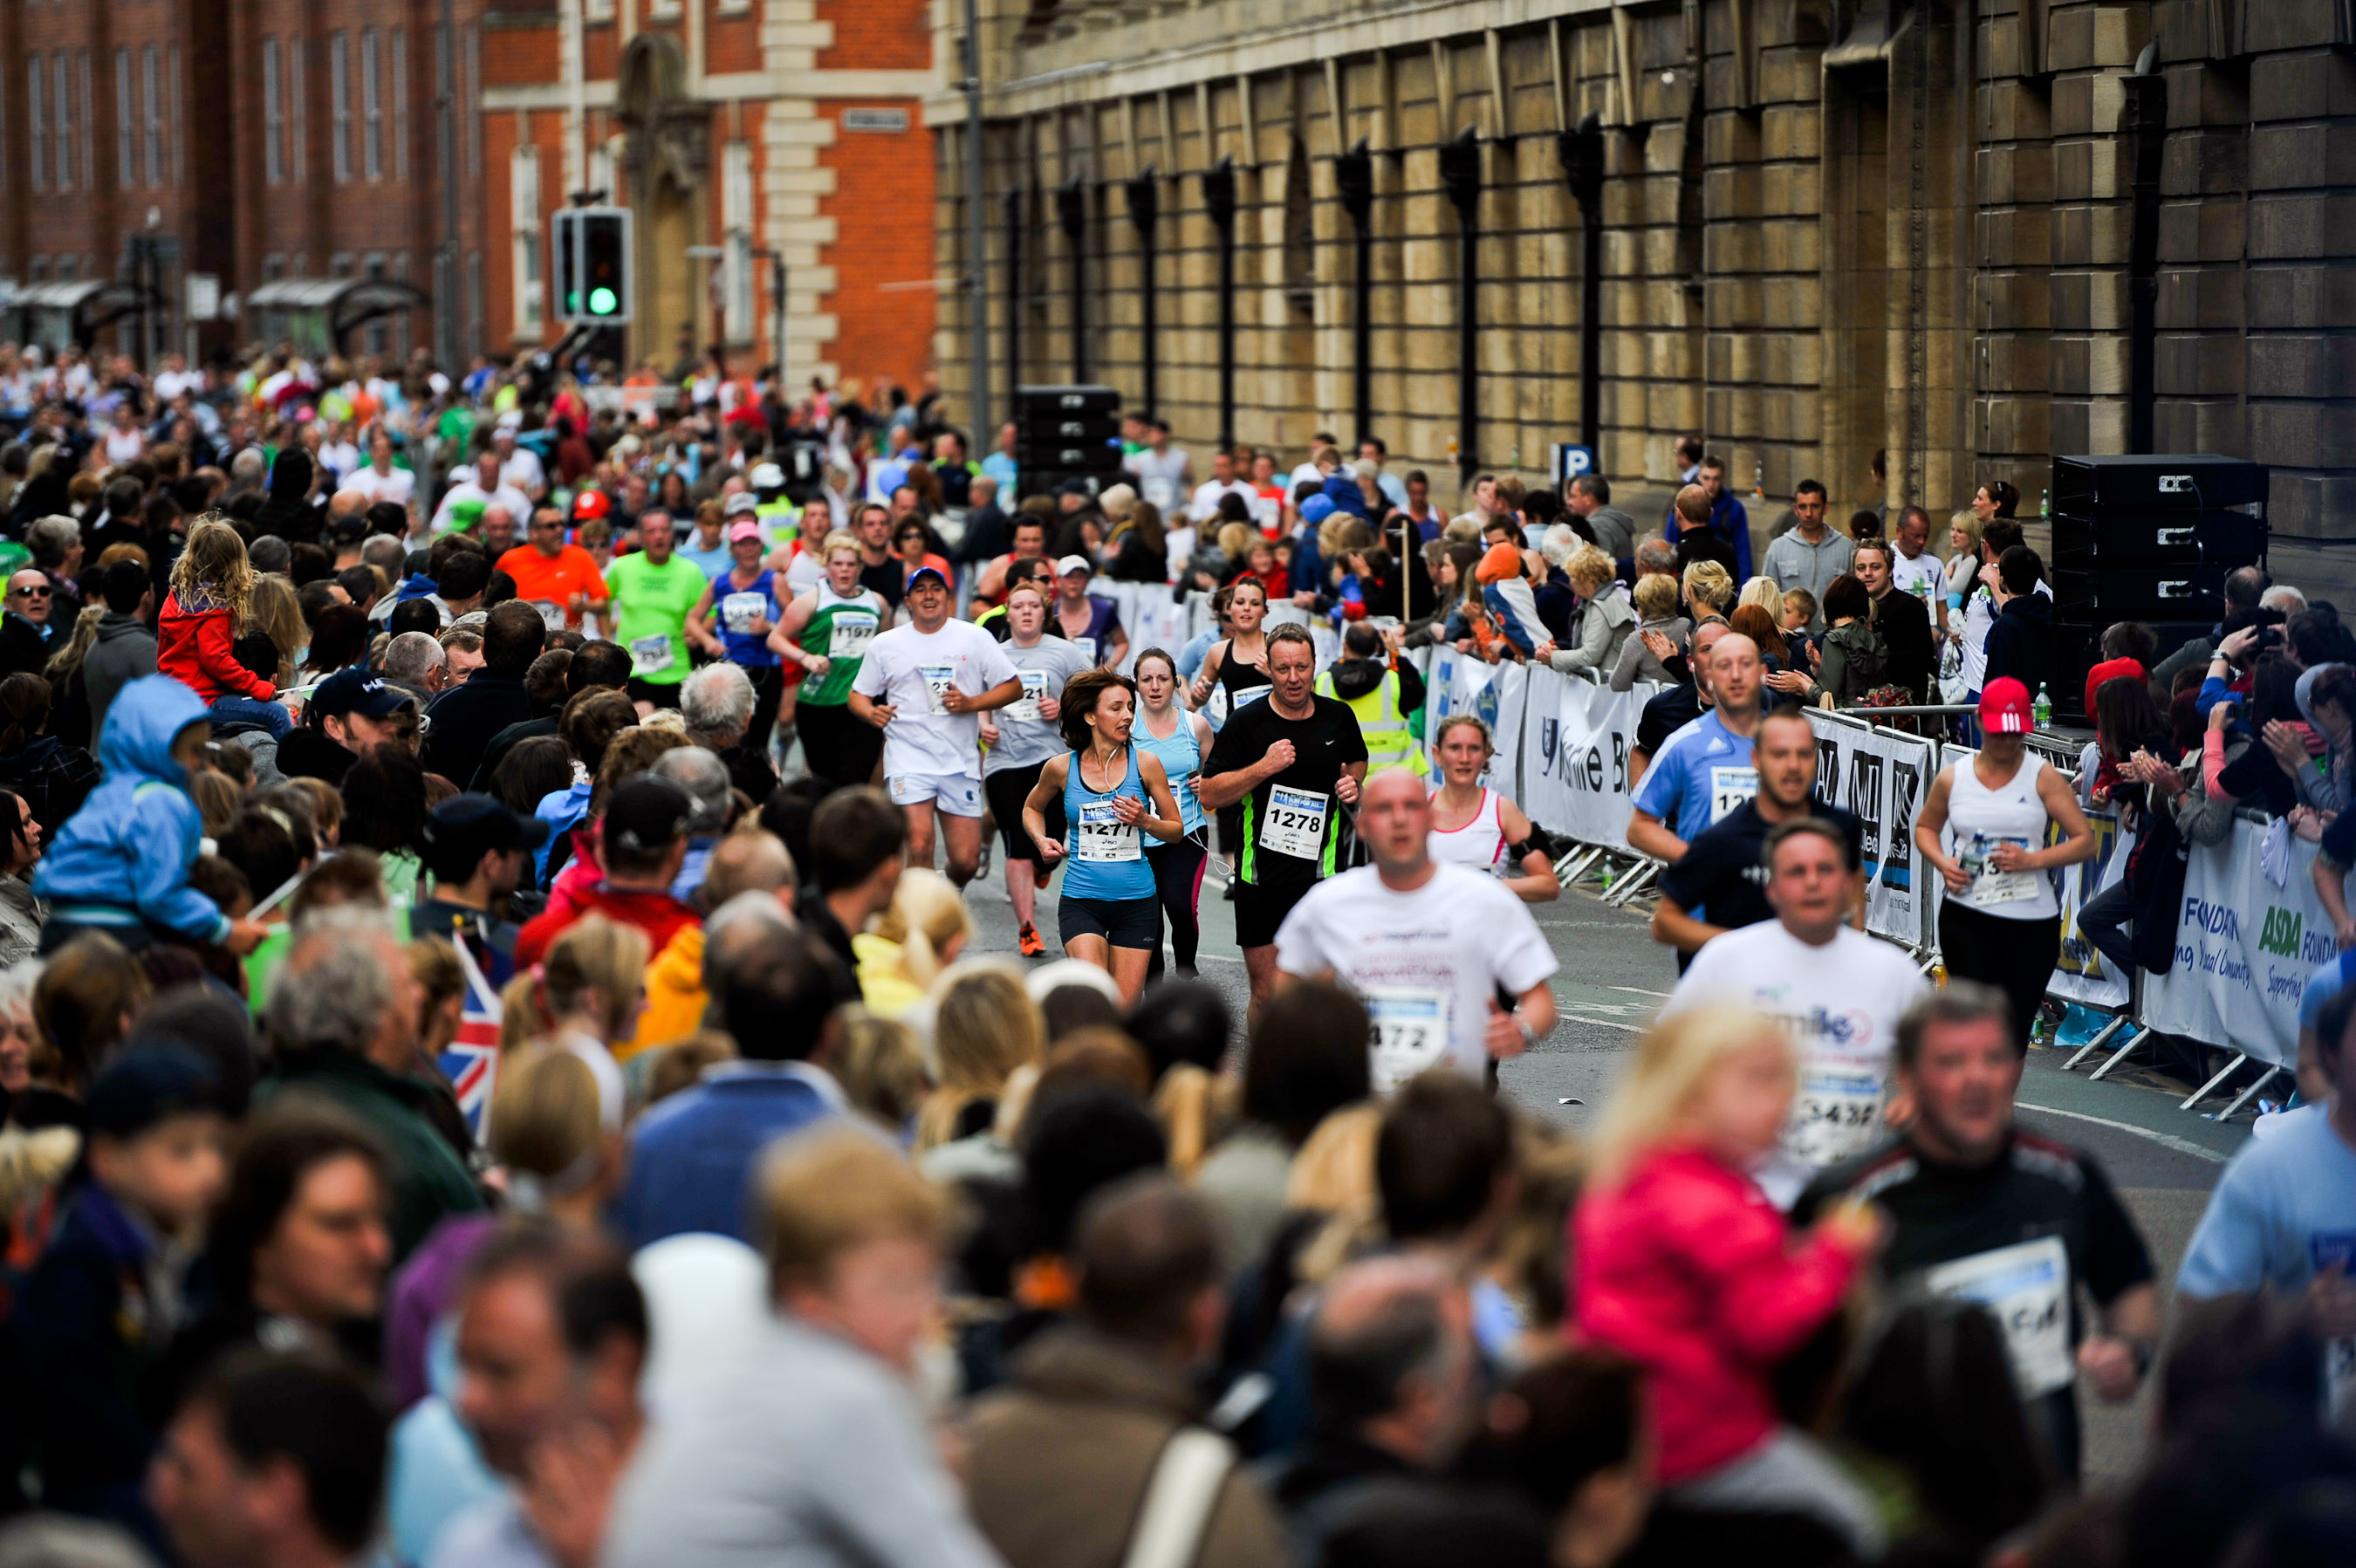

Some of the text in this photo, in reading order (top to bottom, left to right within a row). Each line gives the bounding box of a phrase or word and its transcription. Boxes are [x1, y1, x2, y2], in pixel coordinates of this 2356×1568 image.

[1083, 823, 1133, 838] 1277
[1270, 808, 1321, 833] 1278
[2257, 905, 2303, 960] ASDA
